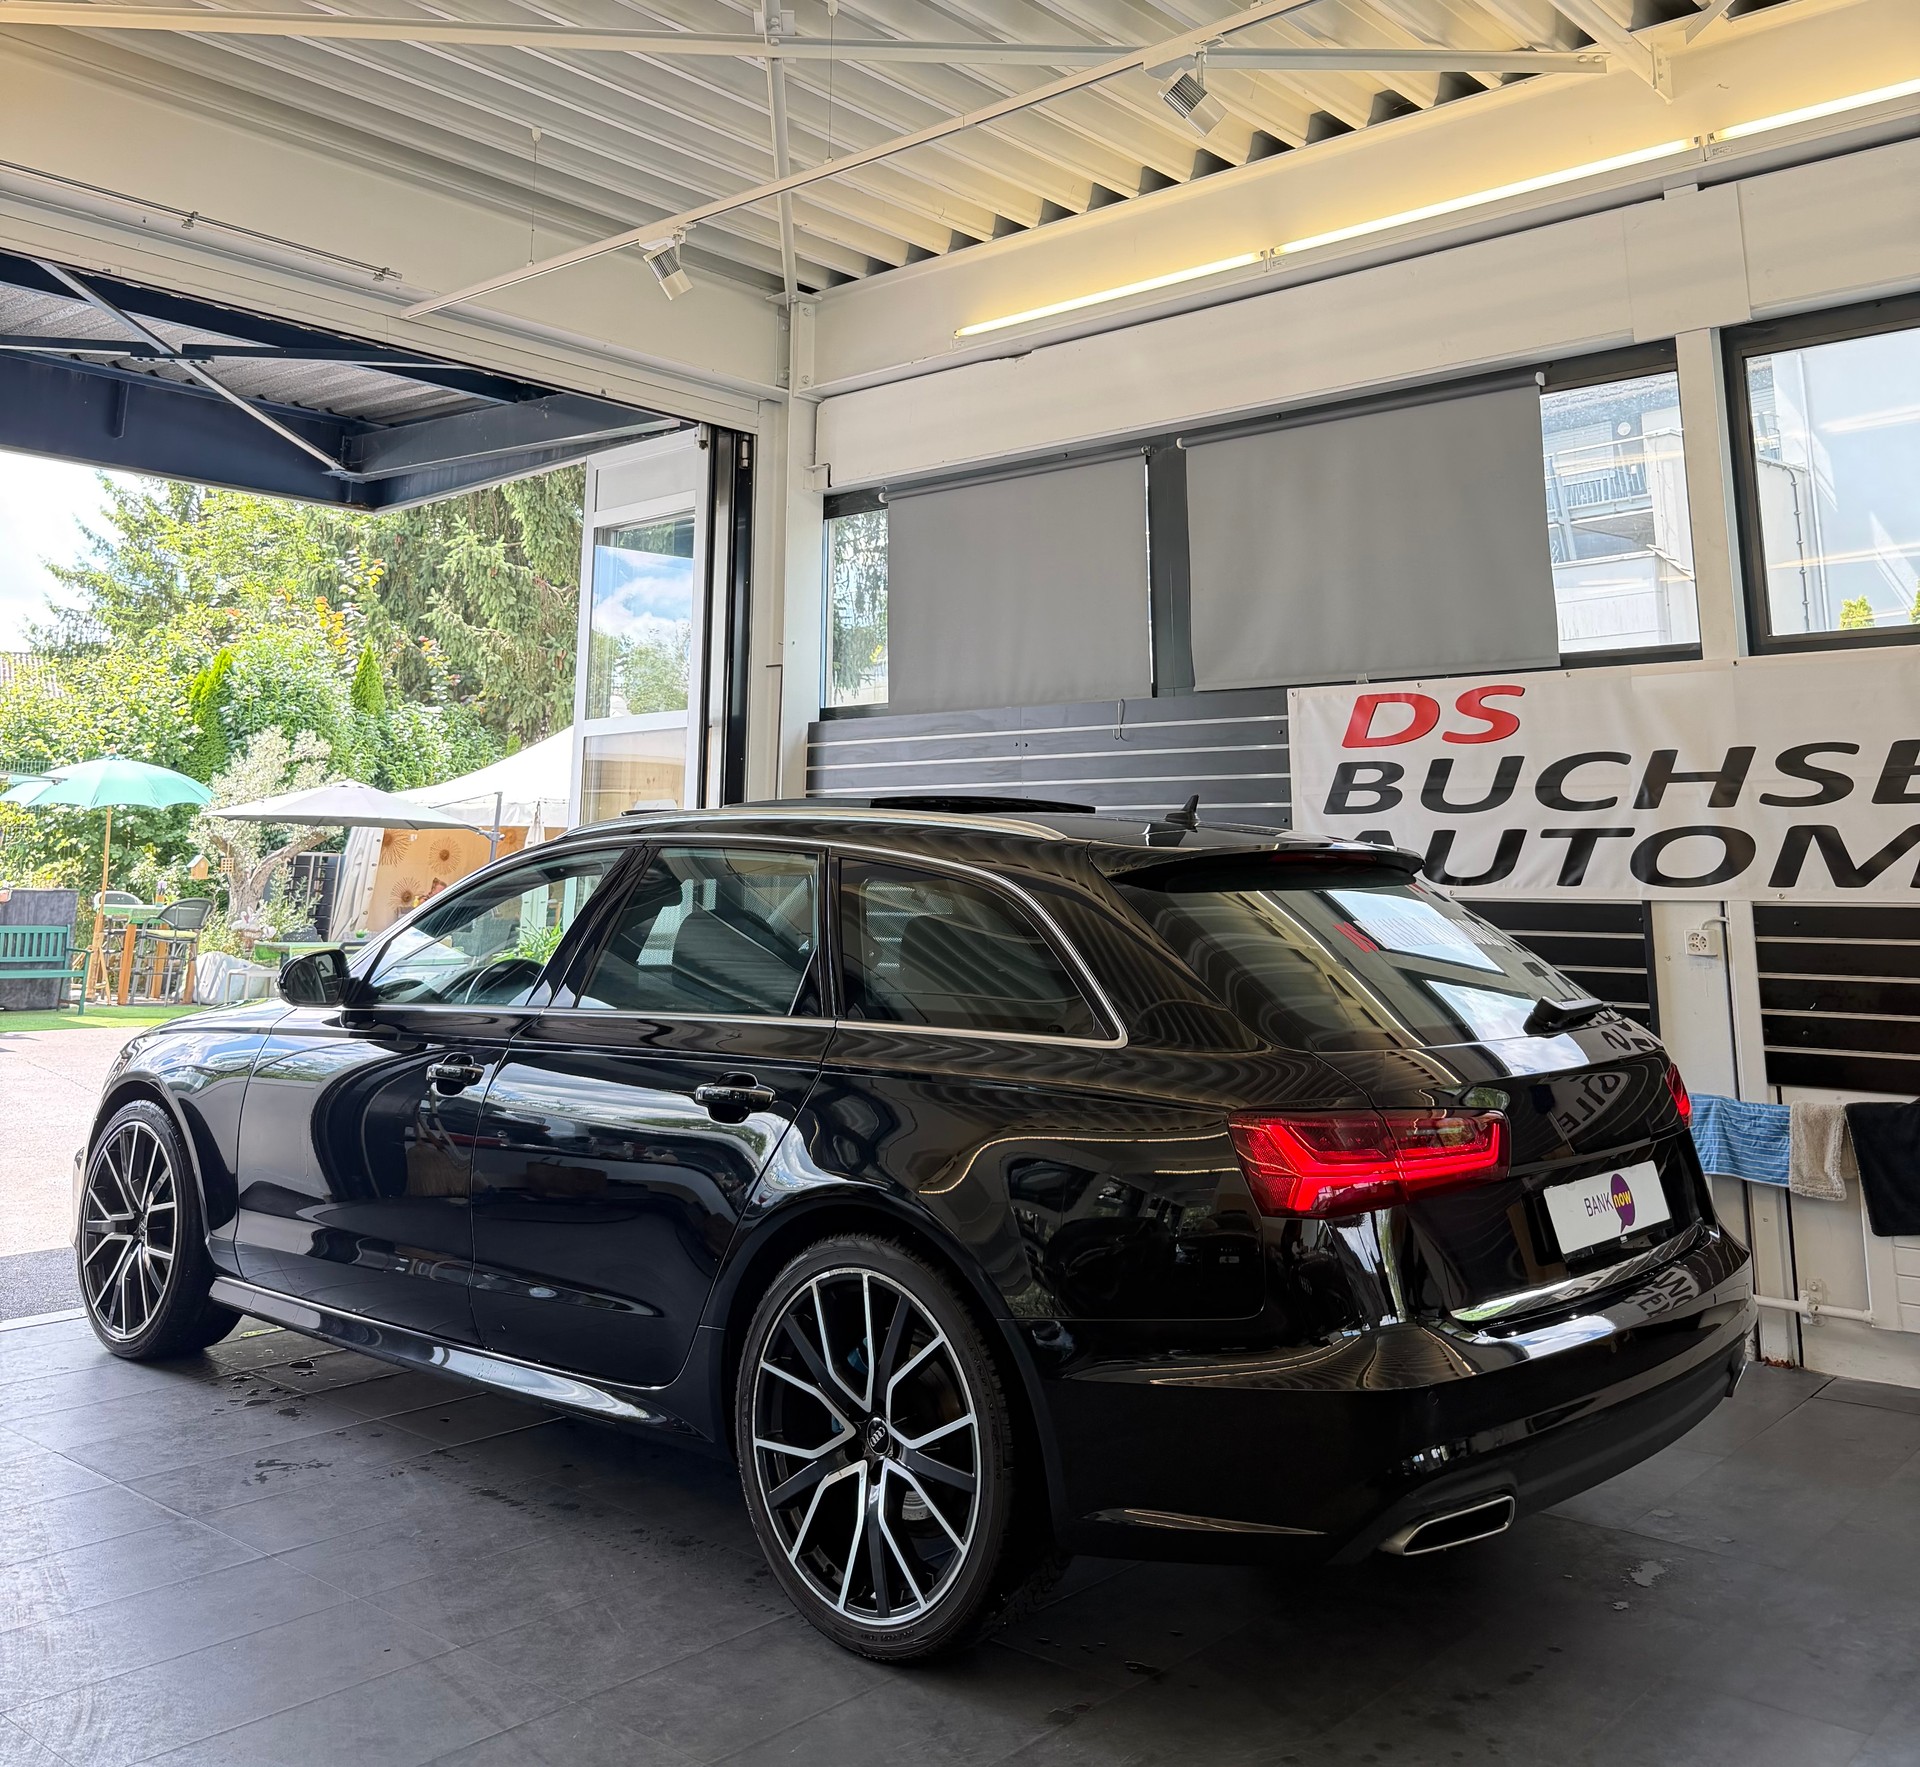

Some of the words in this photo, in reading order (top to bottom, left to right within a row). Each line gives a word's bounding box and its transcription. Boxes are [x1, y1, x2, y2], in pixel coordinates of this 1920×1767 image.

[1341, 685, 1526, 748] DS
[1353, 825, 1920, 888] UTOM
[1583, 1192, 1614, 1218] BANK
[1613, 1190, 1632, 1209] now
